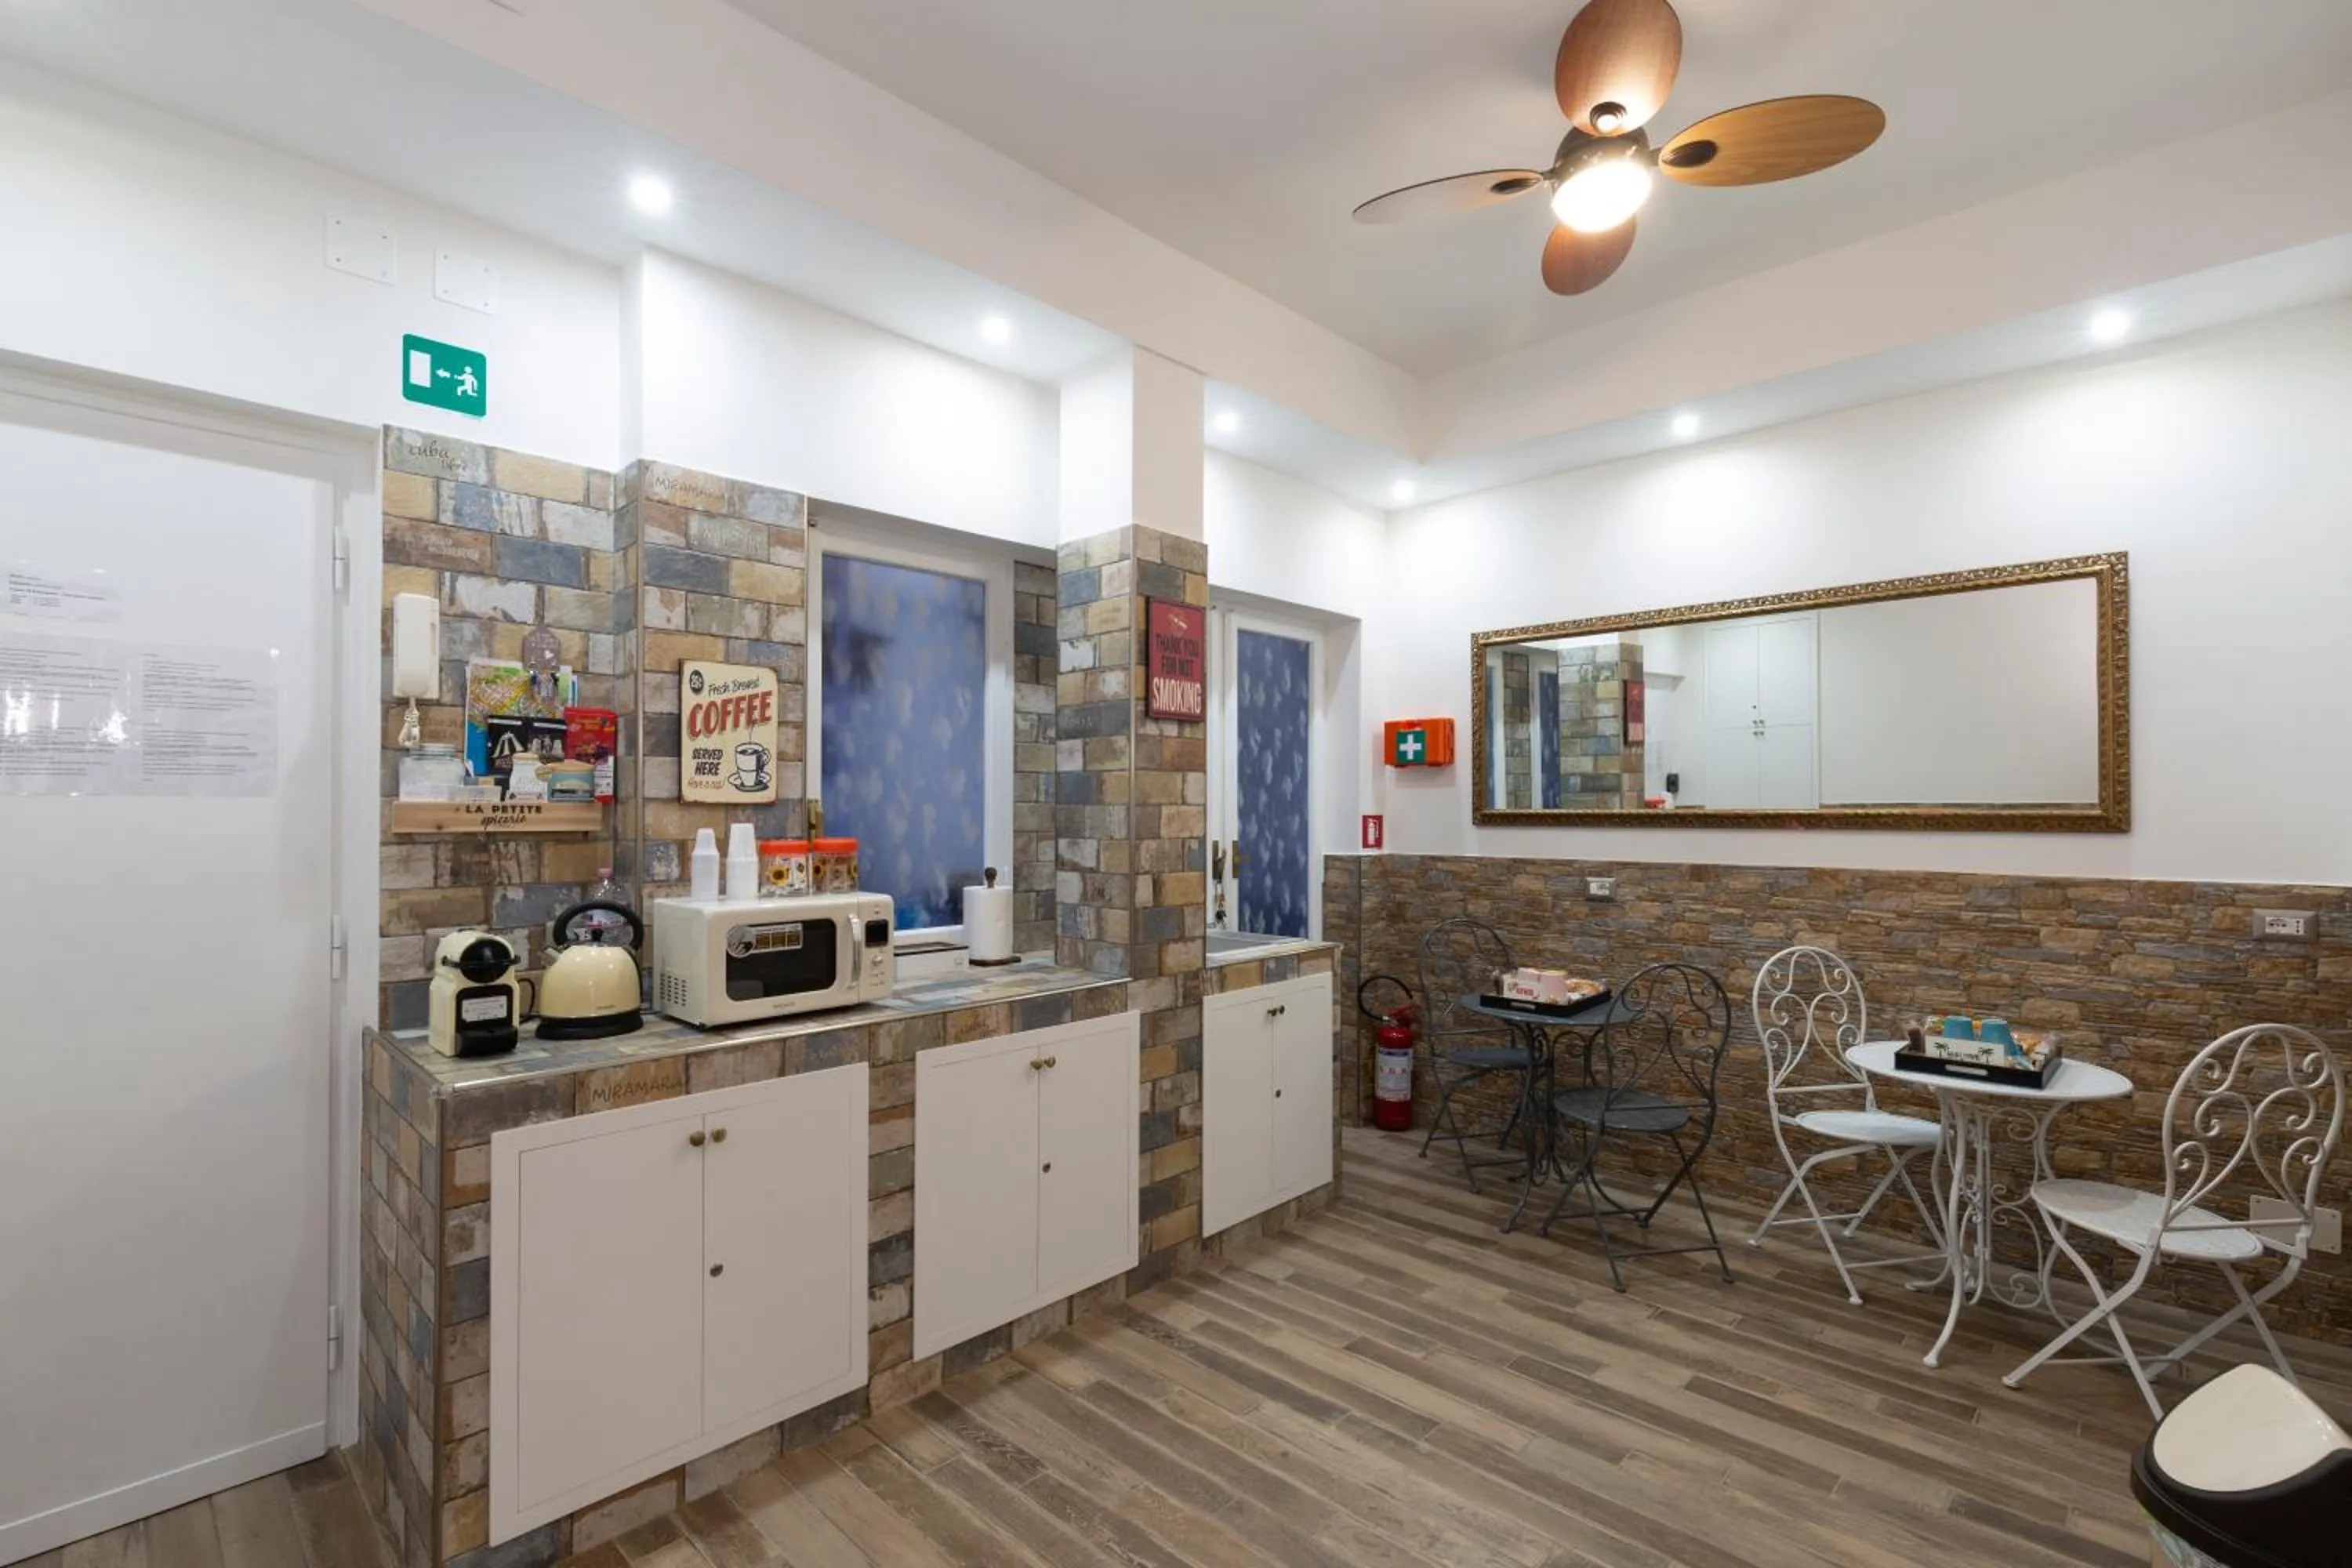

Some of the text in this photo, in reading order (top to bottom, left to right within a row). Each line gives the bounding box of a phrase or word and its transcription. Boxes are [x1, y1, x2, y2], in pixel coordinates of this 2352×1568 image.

[1156, 633, 1200, 659] THANK YOU
[1161, 655, 1194, 677] FOR NOT
[1153, 677, 1202, 714] SMOKING
[688, 690, 772, 741] COFFEE
[691, 747, 724, 761] SERVED
[695, 761, 721, 777] HERE
[465, 804, 543, 815] LA PETITE
